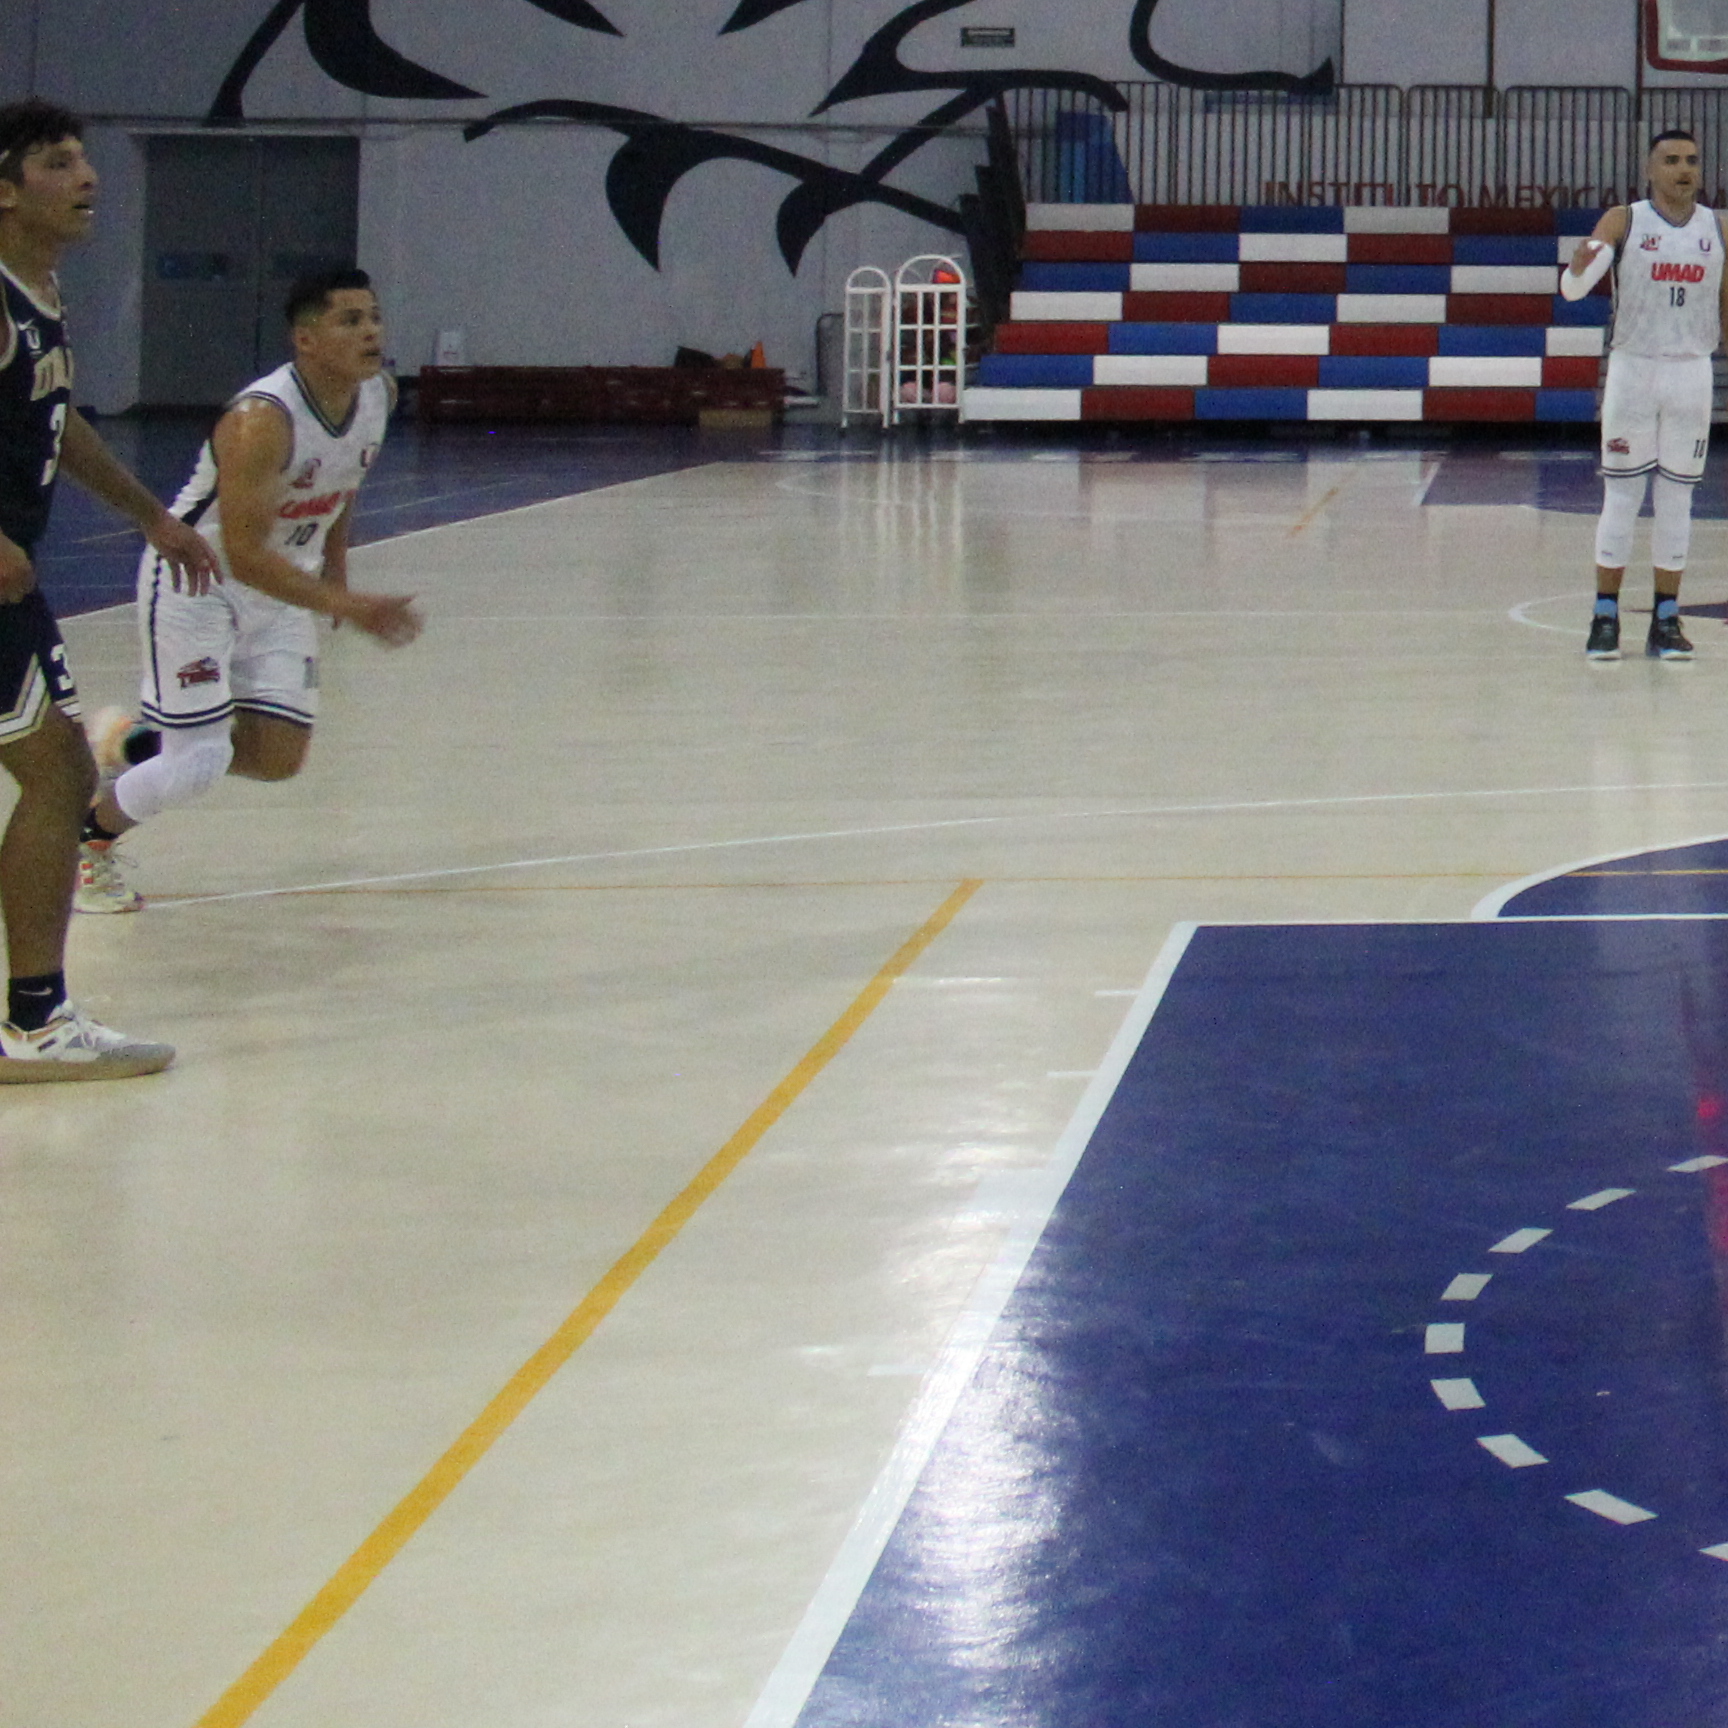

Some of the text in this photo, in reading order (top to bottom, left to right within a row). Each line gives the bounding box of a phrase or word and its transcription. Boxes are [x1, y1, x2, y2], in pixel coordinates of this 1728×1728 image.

[1482, 182, 1652, 210] MEXICAN
[1651, 262, 1706, 283] UMAD
[1669, 285, 1686, 307] 18
